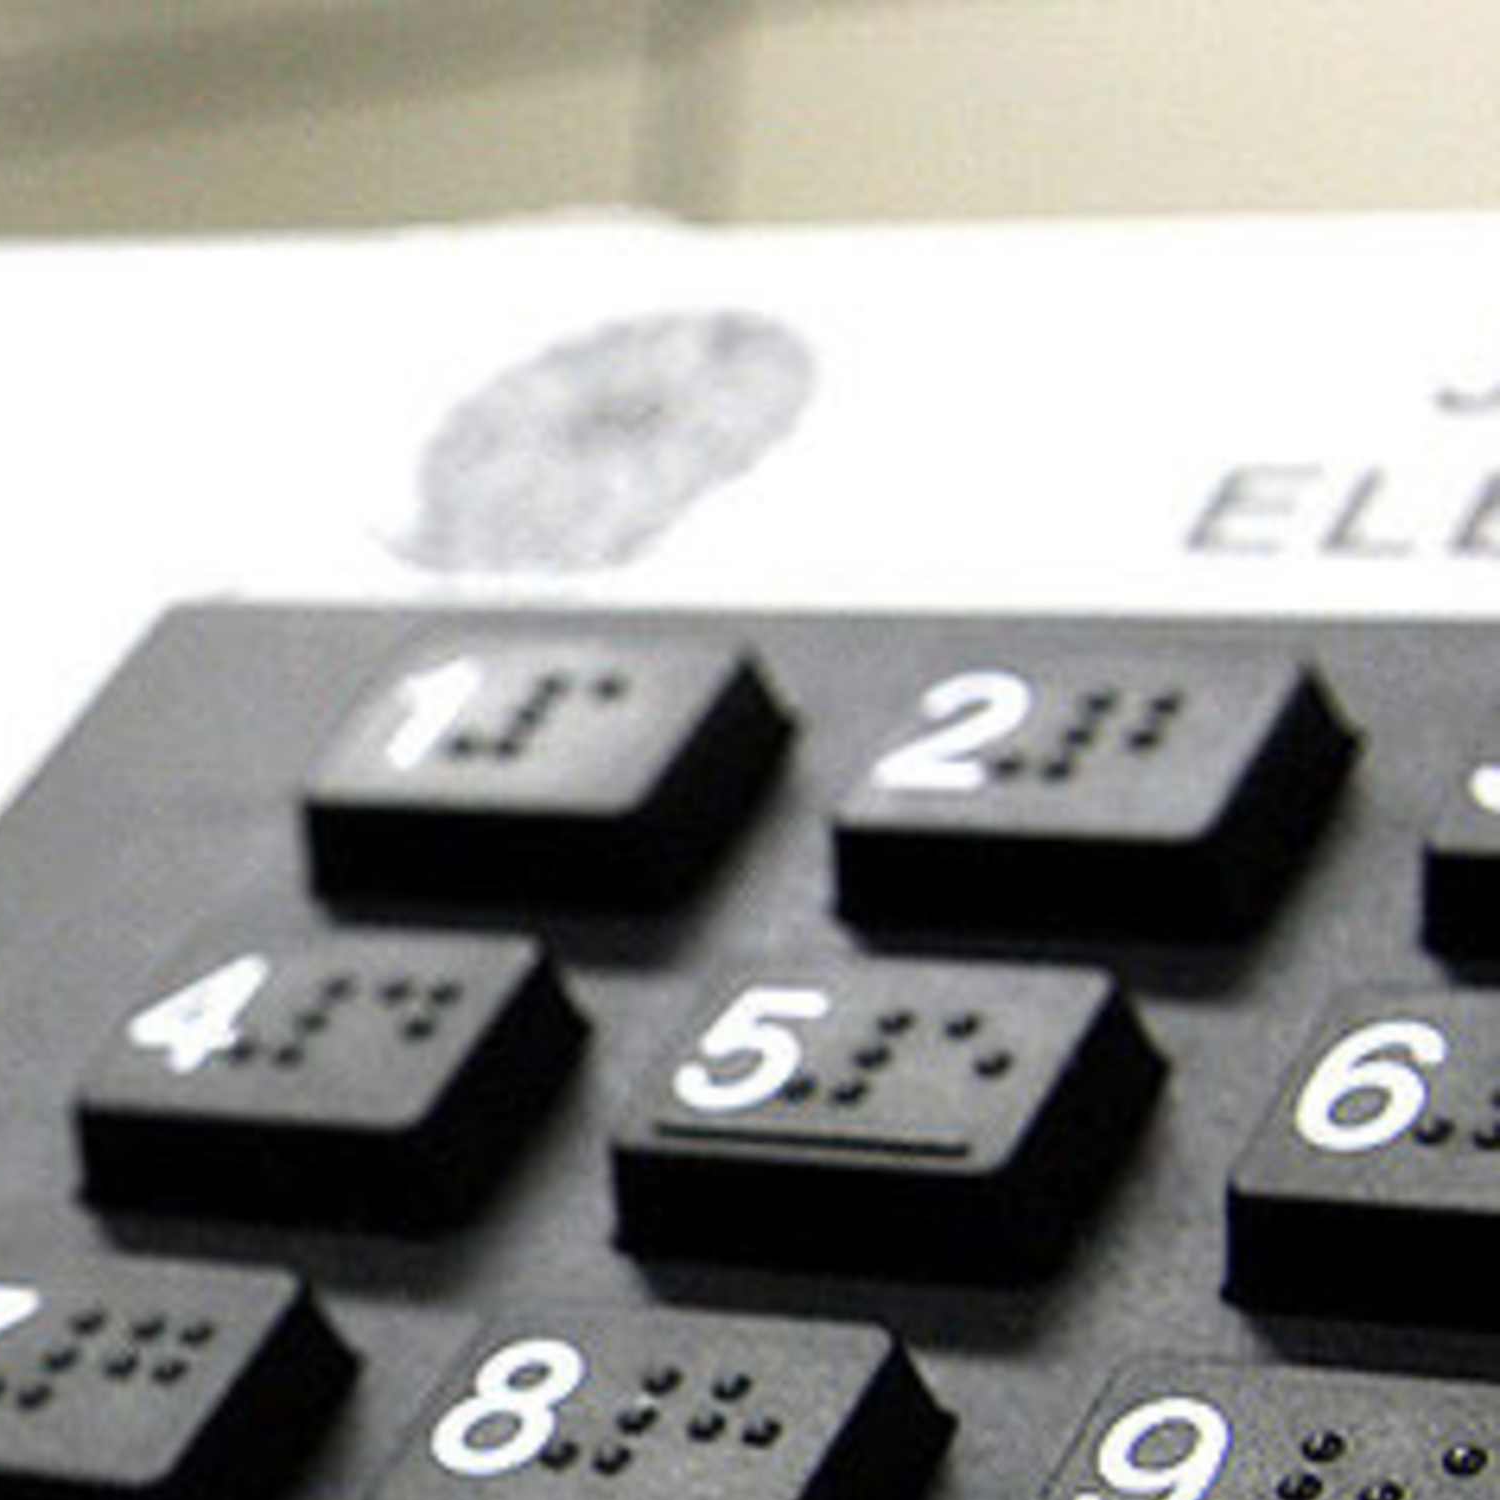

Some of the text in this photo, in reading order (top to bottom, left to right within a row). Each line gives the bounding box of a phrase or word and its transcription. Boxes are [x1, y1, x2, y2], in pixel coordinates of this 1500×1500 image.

[384, 656, 484, 772] 1
[872, 673, 1030, 789] 2
[129, 956, 268, 1073] 4
[674, 987, 830, 1110] 5
[1296, 1022, 1445, 1150] 6
[432, 1340, 582, 1474] 8
